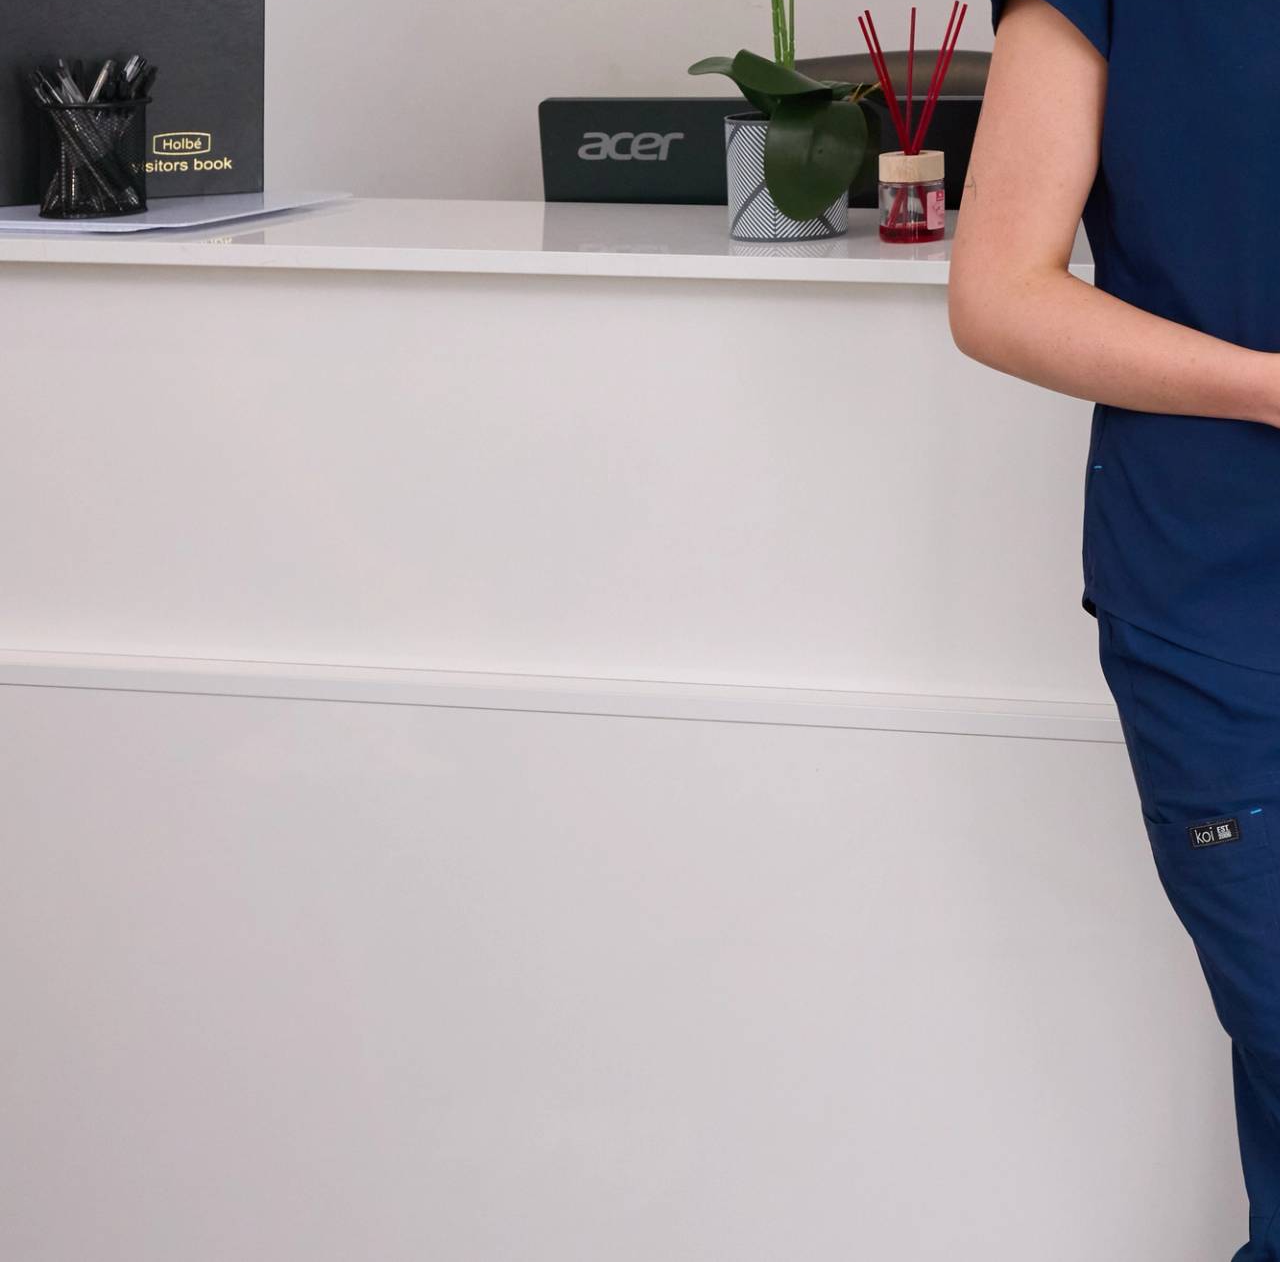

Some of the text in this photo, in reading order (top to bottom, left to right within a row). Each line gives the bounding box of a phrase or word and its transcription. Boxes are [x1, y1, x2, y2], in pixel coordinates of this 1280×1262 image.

[162, 137, 202, 151] Holbé
[577, 131, 685, 161] acer
[144, 156, 233, 174] sitors book
[1194, 826, 1215, 844] koi
